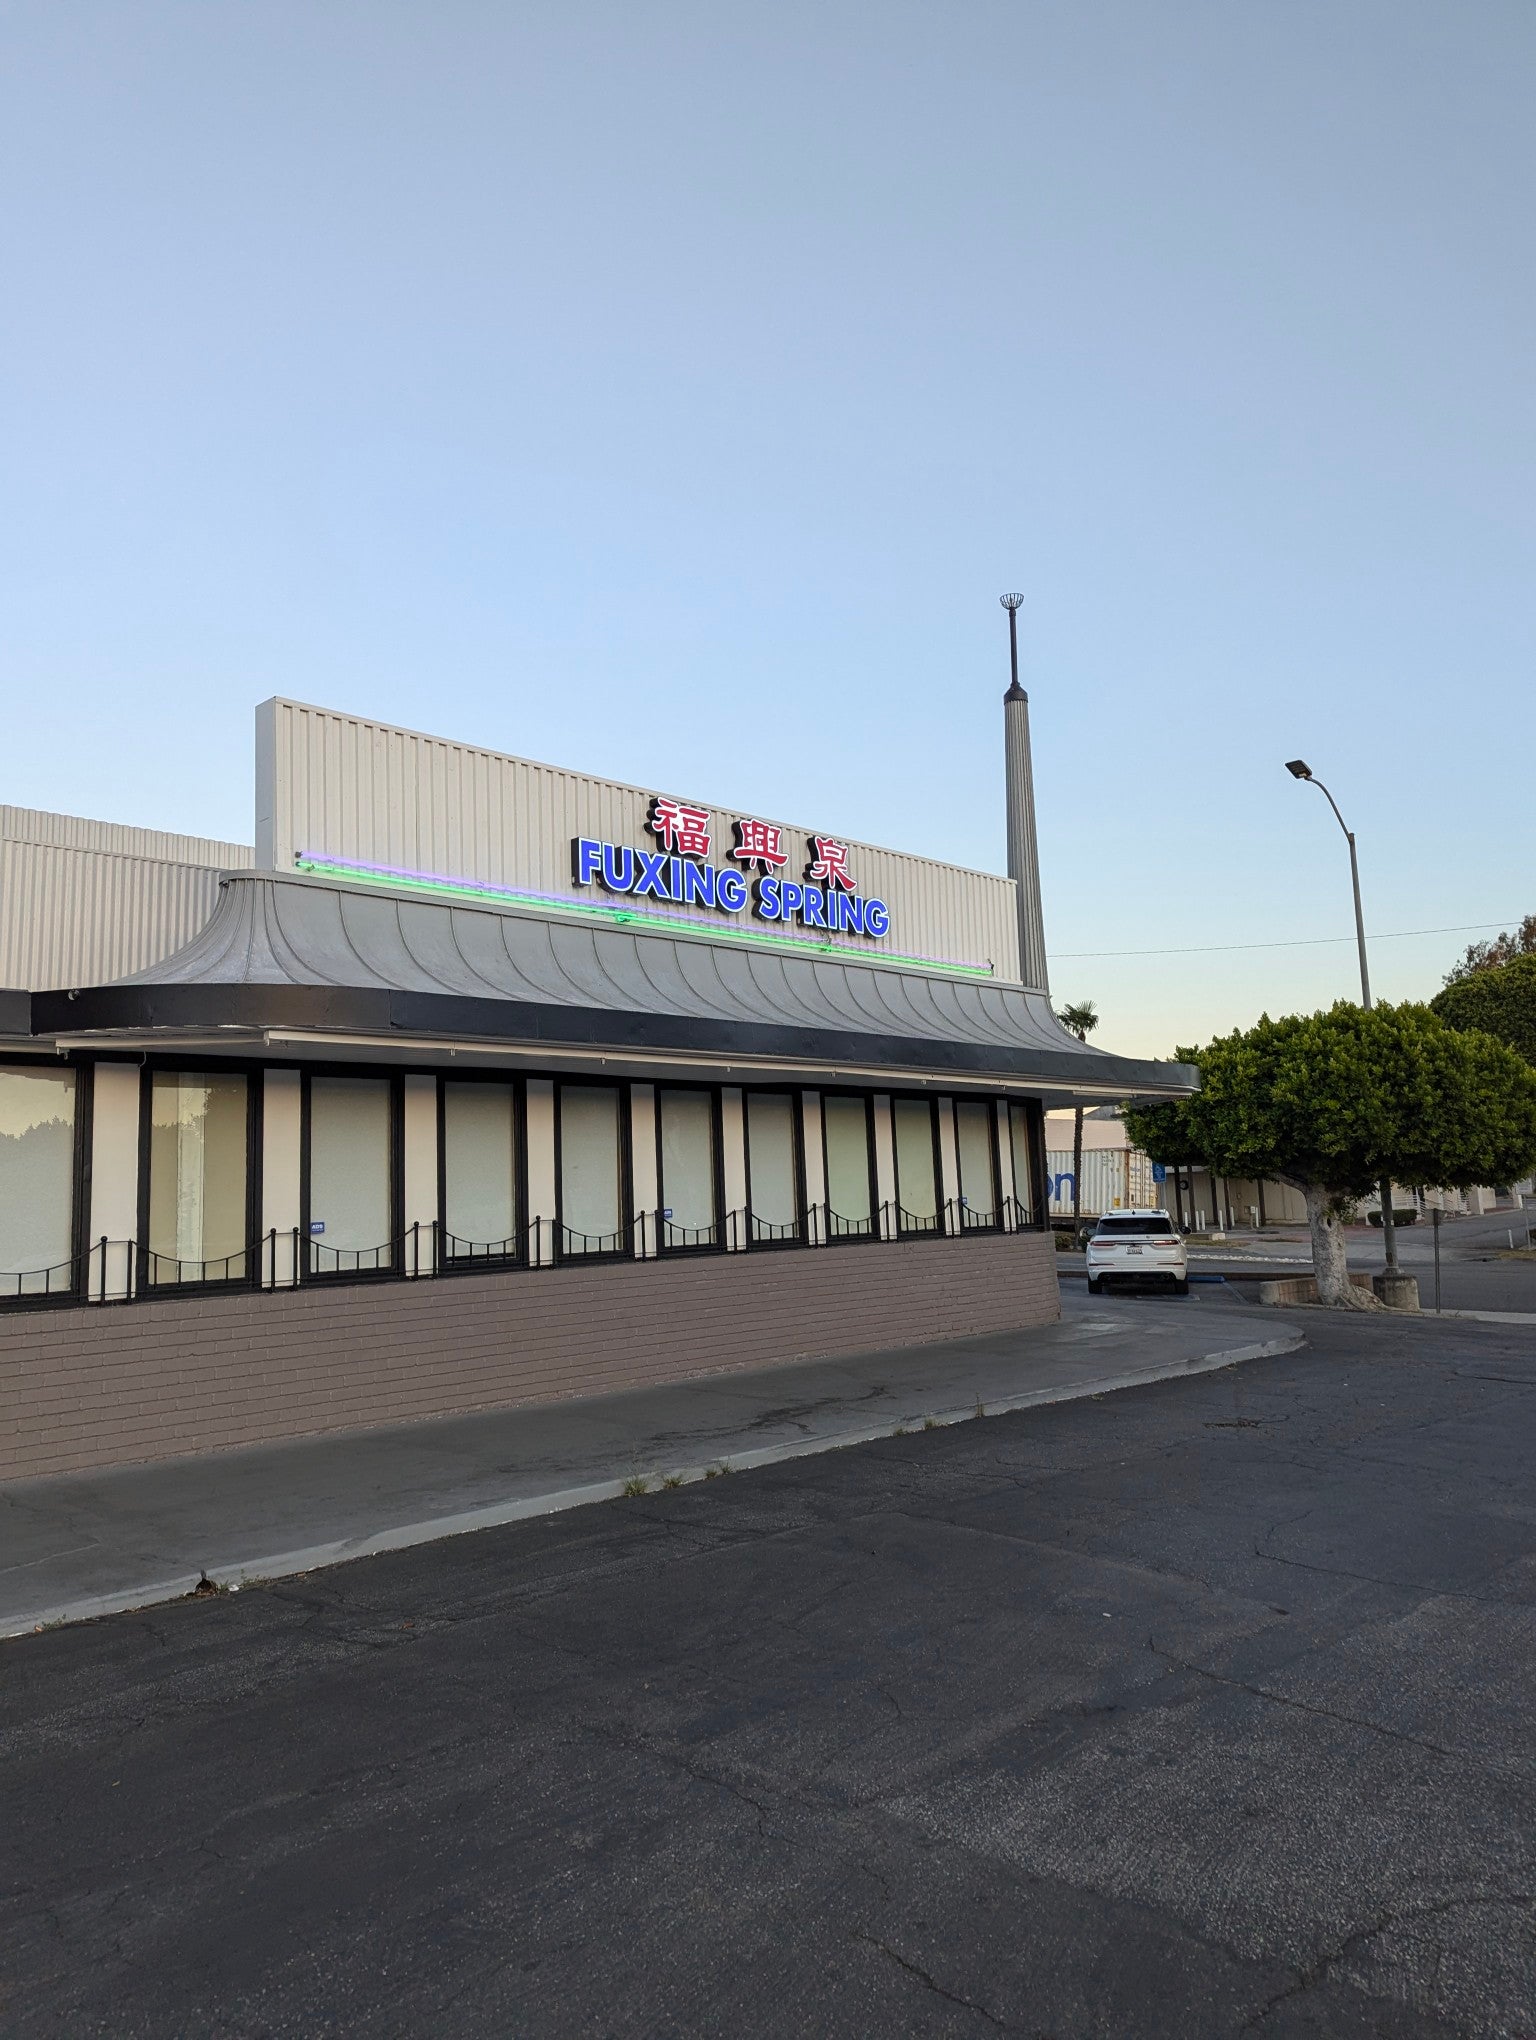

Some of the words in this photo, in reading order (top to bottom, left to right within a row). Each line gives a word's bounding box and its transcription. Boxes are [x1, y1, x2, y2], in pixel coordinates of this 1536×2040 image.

[578, 837, 748, 913] FUXING
[759, 876, 890, 938] SPRING
[653, 796, 857, 891] 福興泉
